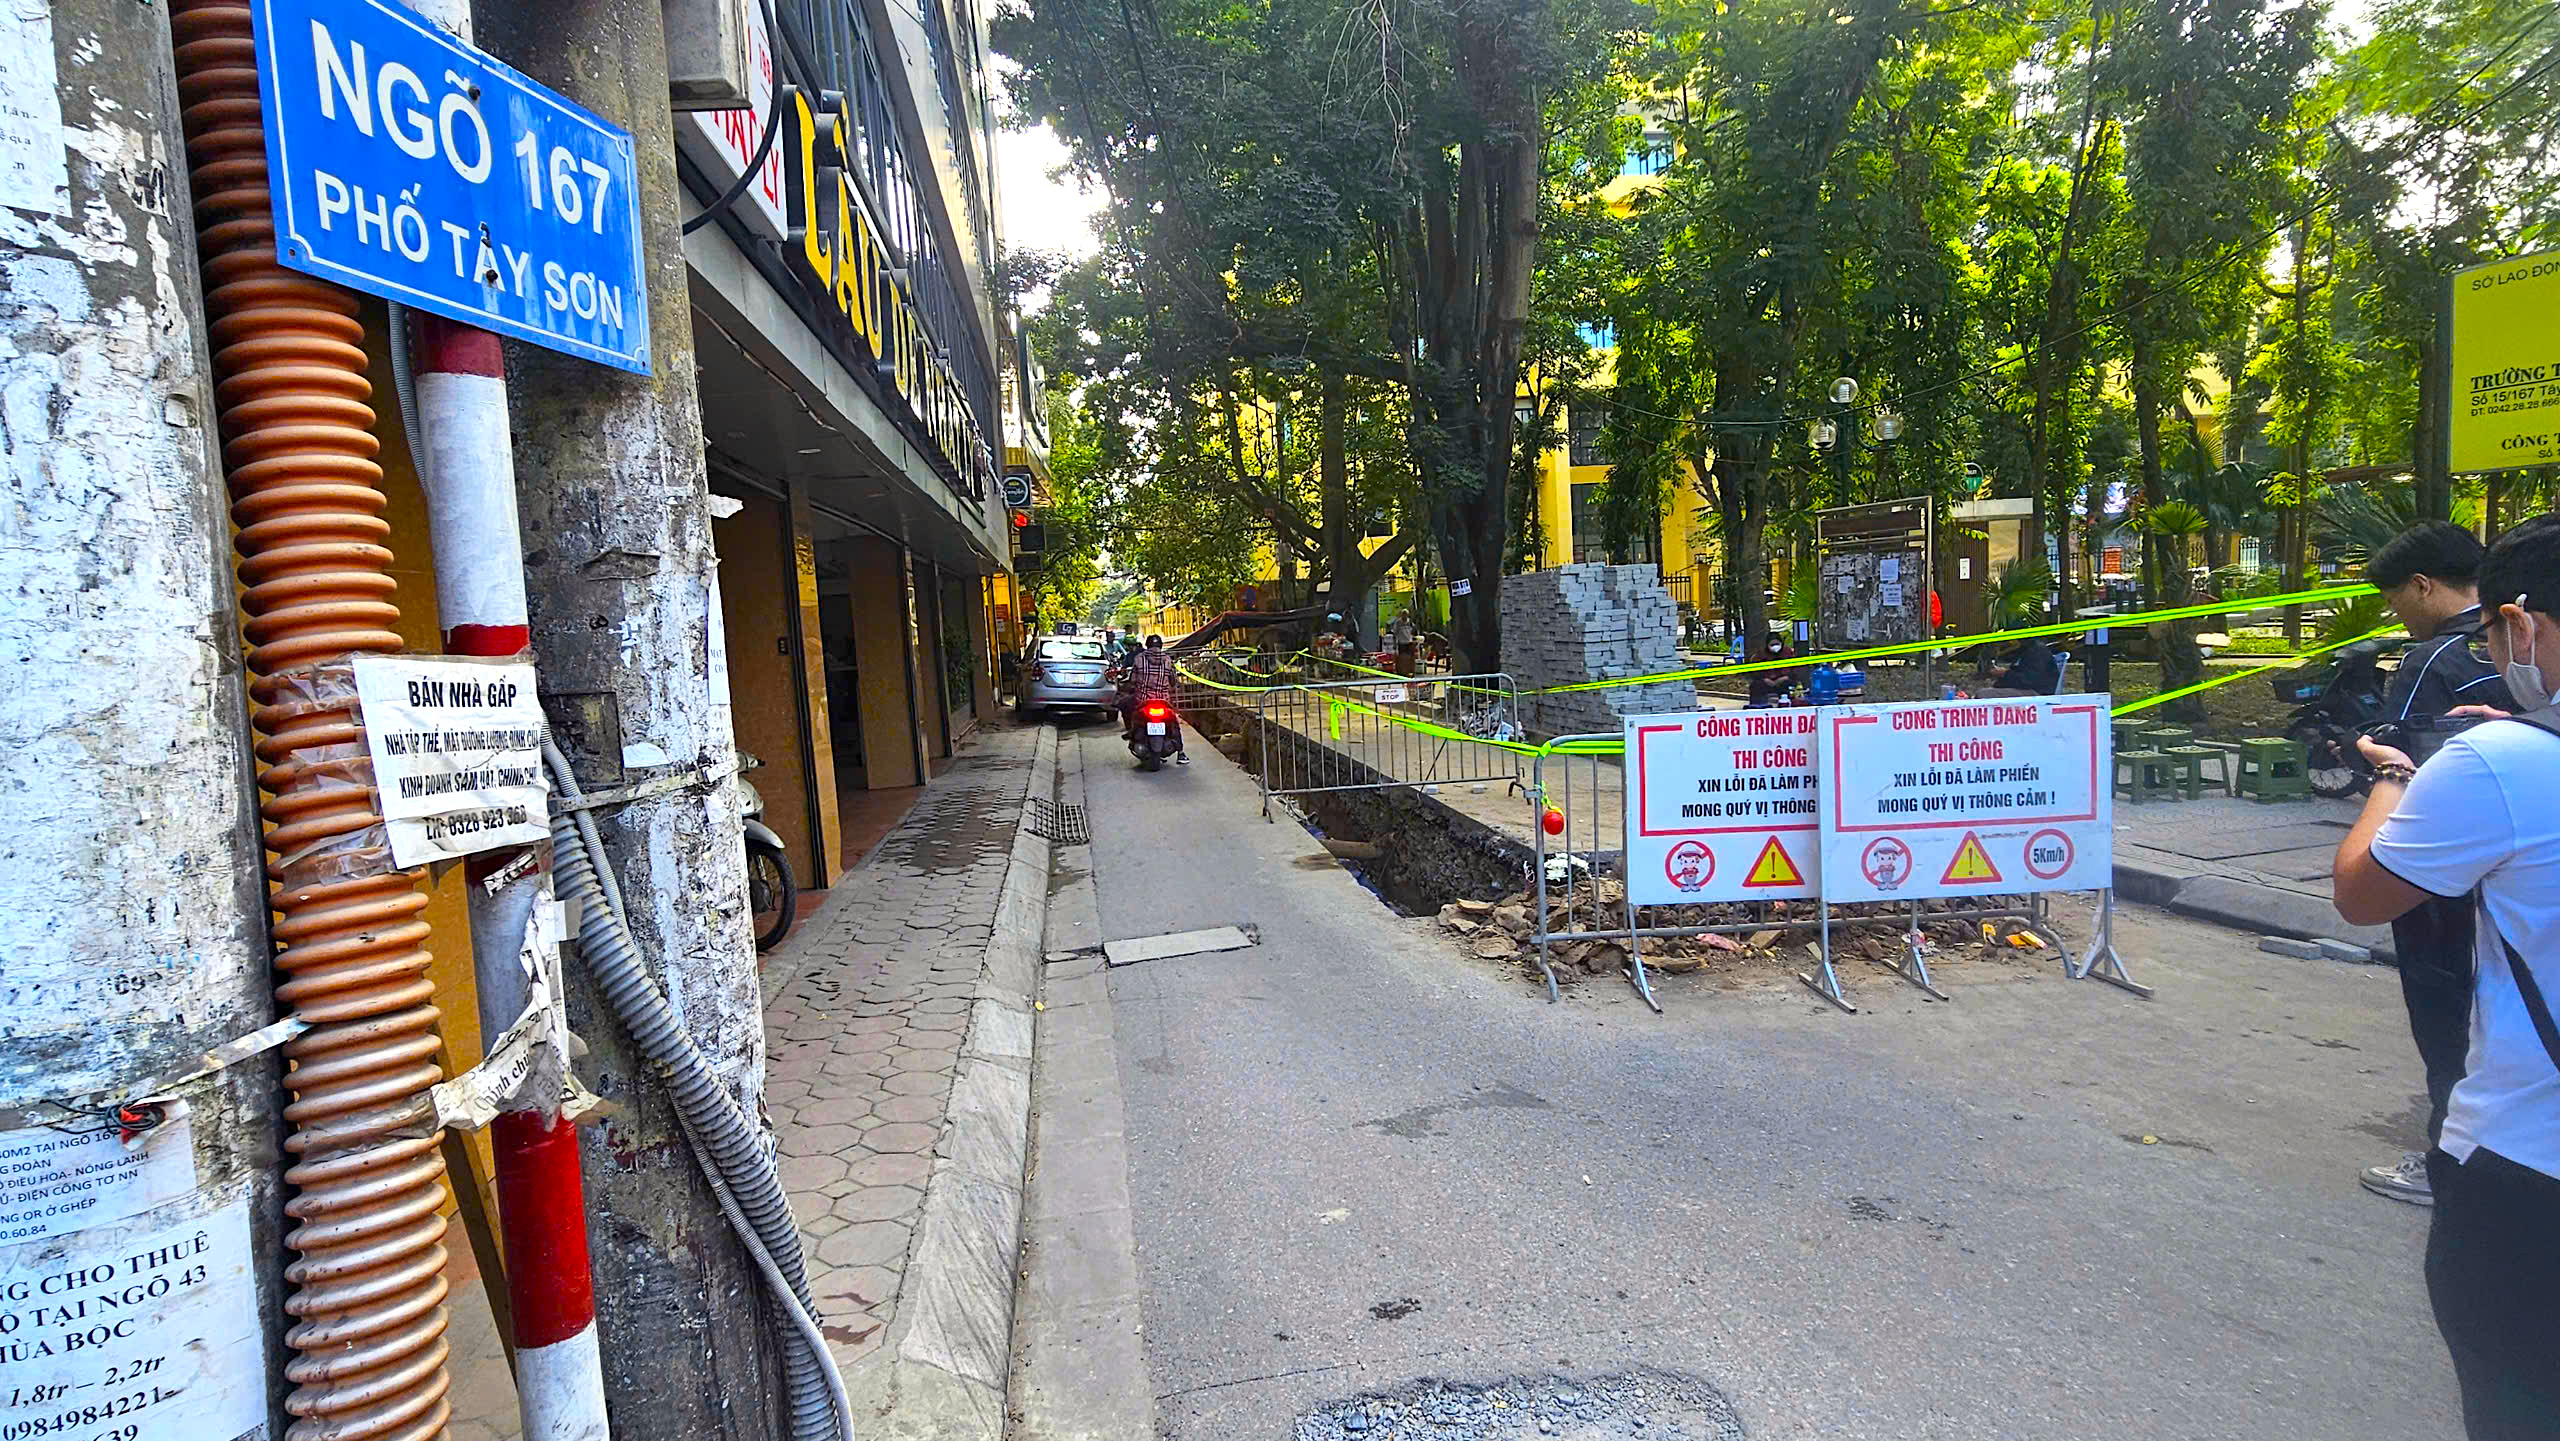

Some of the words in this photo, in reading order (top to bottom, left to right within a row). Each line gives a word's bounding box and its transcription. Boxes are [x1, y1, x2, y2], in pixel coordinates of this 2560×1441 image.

[311, 19, 492, 184] NGÕ
[515, 130, 610, 235] 167
[315, 169, 431, 263] PHỐ
[441, 222, 530, 298] TÂY
[543, 261, 624, 330] SƠN
[2498, 268, 2528, 285] LAO
[2471, 366, 2545, 390] TRƯỜNG
[2471, 393, 2488, 406] Số
[2493, 387, 2535, 403] 15/167
[2502, 434, 2548, 450] CÔNG
[408, 676, 444, 708] BÁN
[449, 677, 483, 708] NHÀ
[1697, 715, 1740, 738] CÔNG
[1745, 713, 1793, 736] TRÌNH
[1993, 705, 2038, 726] ĐANG
[384, 728, 407, 756] NHÀ
[1928, 743, 1954, 763] THI
[1959, 737, 2003, 762] CÔNG
[1733, 748, 1757, 769] THI
[1763, 745, 1807, 768] CÔNG
[399, 775, 423, 799] KINH
[425, 773, 453, 796] DOANH
[1698, 778, 1721, 793] XIN
[1725, 773, 1745, 792] LỖI
[1749, 774, 1767, 791] ĐÃ
[1771, 773, 1799, 790] LÀM
[1893, 772, 1917, 788] XIN
[1920, 766, 1941, 786] LỖI
[1945, 767, 1963, 785] ĐÃ
[1967, 766, 1996, 784] LÀM
[1682, 803, 1722, 818] MONG
[1725, 798, 1751, 816] QUÝ
[1755, 801, 1768, 818] VỊ
[1771, 797, 1816, 814] THÔNG
[1878, 798, 1918, 814] MONG
[1922, 793, 1948, 812] QUÝ
[1951, 795, 1965, 812] VỊ
[1969, 791, 2012, 809] THÔNG
[2016, 787, 2047, 806] CẢM
[481, 808, 504, 830] 923
[505, 804, 527, 826] 368
[2033, 846, 2065, 863] 5Km/h
[34, 1142, 56, 1154] TẠI
[60, 1134, 91, 1150] NGÕ
[52, 1180, 92, 1196] CÔNG
[95, 1174, 115, 1187] TƠ
[118, 1169, 139, 1182] NN
[23, 1209, 43, 1221] OR
[40, 1263, 116, 1295] CHO
[124, 1230, 211, 1275] THUÊ
[29, 1299, 89, 1328] TẠI
[97, 1274, 171, 1314] NGÕ
[179, 1264, 207, 1287] 43
[64, 1318, 137, 1352] BỘC
[10, 1381, 70, 1409] 1,8tr
[104, 1354, 166, 1387] 2,2tr
